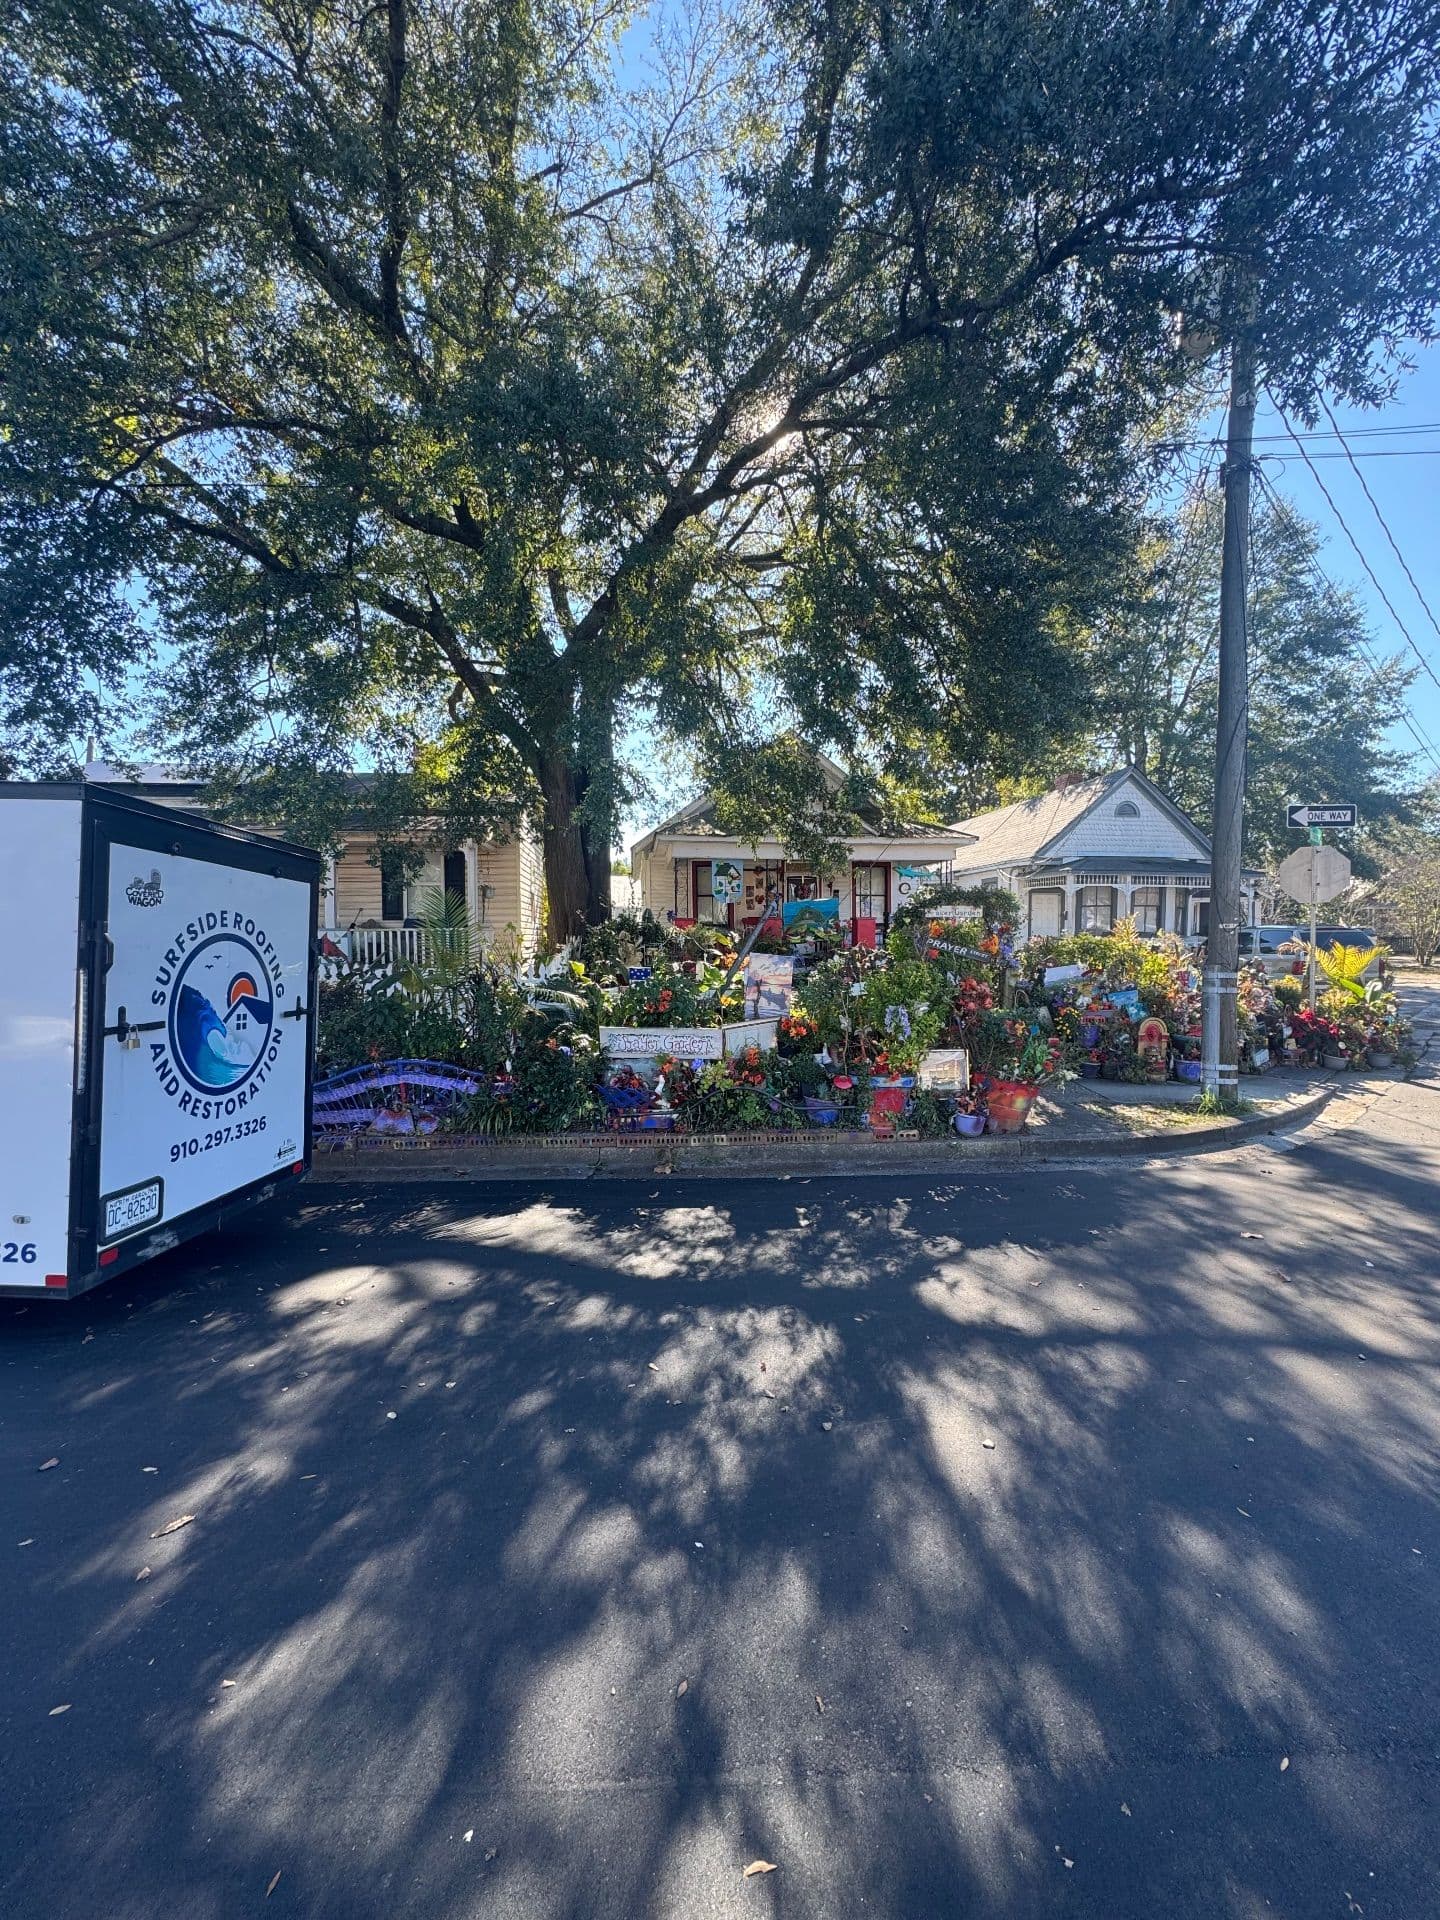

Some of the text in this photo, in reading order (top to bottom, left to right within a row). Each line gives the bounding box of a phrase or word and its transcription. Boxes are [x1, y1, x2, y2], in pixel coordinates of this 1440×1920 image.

[1308, 812, 1348, 821] ONE WAY
[126, 887, 164, 898] COVERED
[128, 895, 162, 907] WAGON
[151, 910, 285, 1006] SURFSIDE ROOFING
[926, 938, 968, 956] PRAYER
[150, 1028, 283, 1119] AND RESTORATION
[170, 1115, 266, 1162] 910.297.3326
[107, 1192, 157, 1227] DC-82630
[0, 1242, 37, 1264] 26
